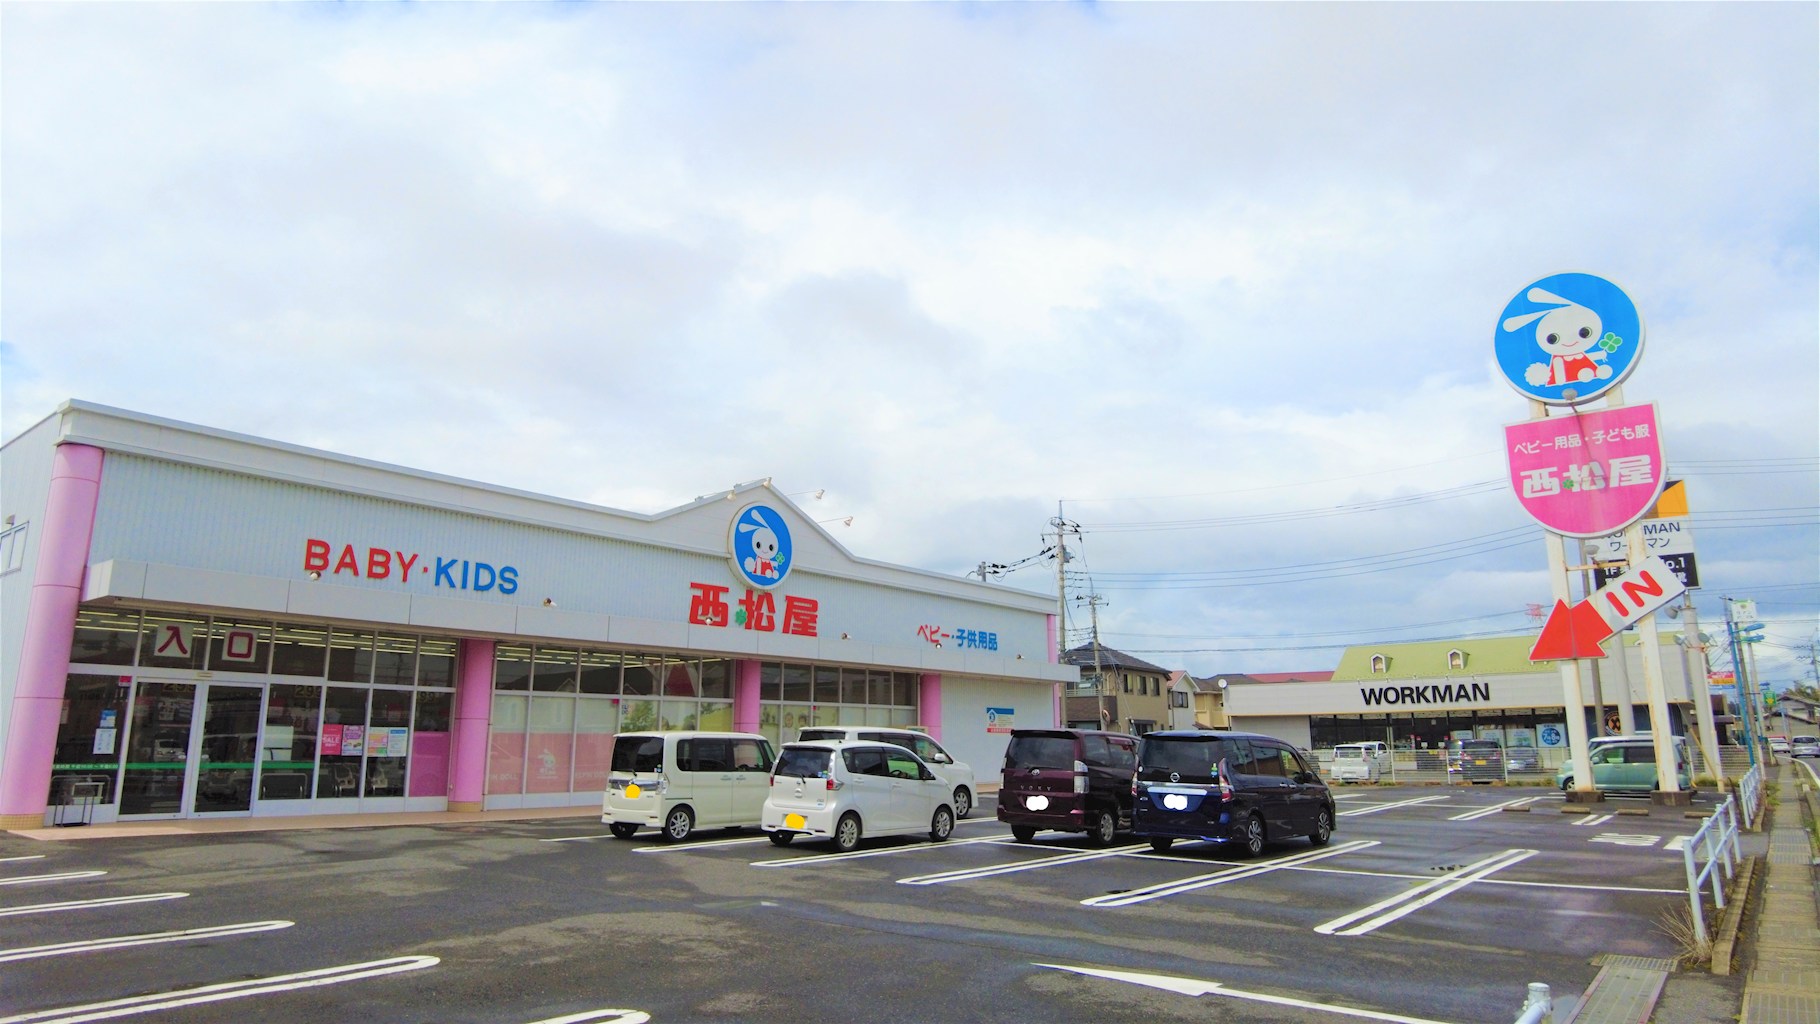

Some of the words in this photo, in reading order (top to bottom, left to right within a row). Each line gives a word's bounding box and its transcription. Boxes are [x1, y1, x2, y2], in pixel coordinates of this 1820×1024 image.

[1520, 455, 1654, 498] 西松屋
[689, 582, 818, 636] 西松屋
[1605, 570, 1663, 617] IN
[157, 626, 254, 659] 入口
[1361, 683, 1490, 705] WORKMAN
